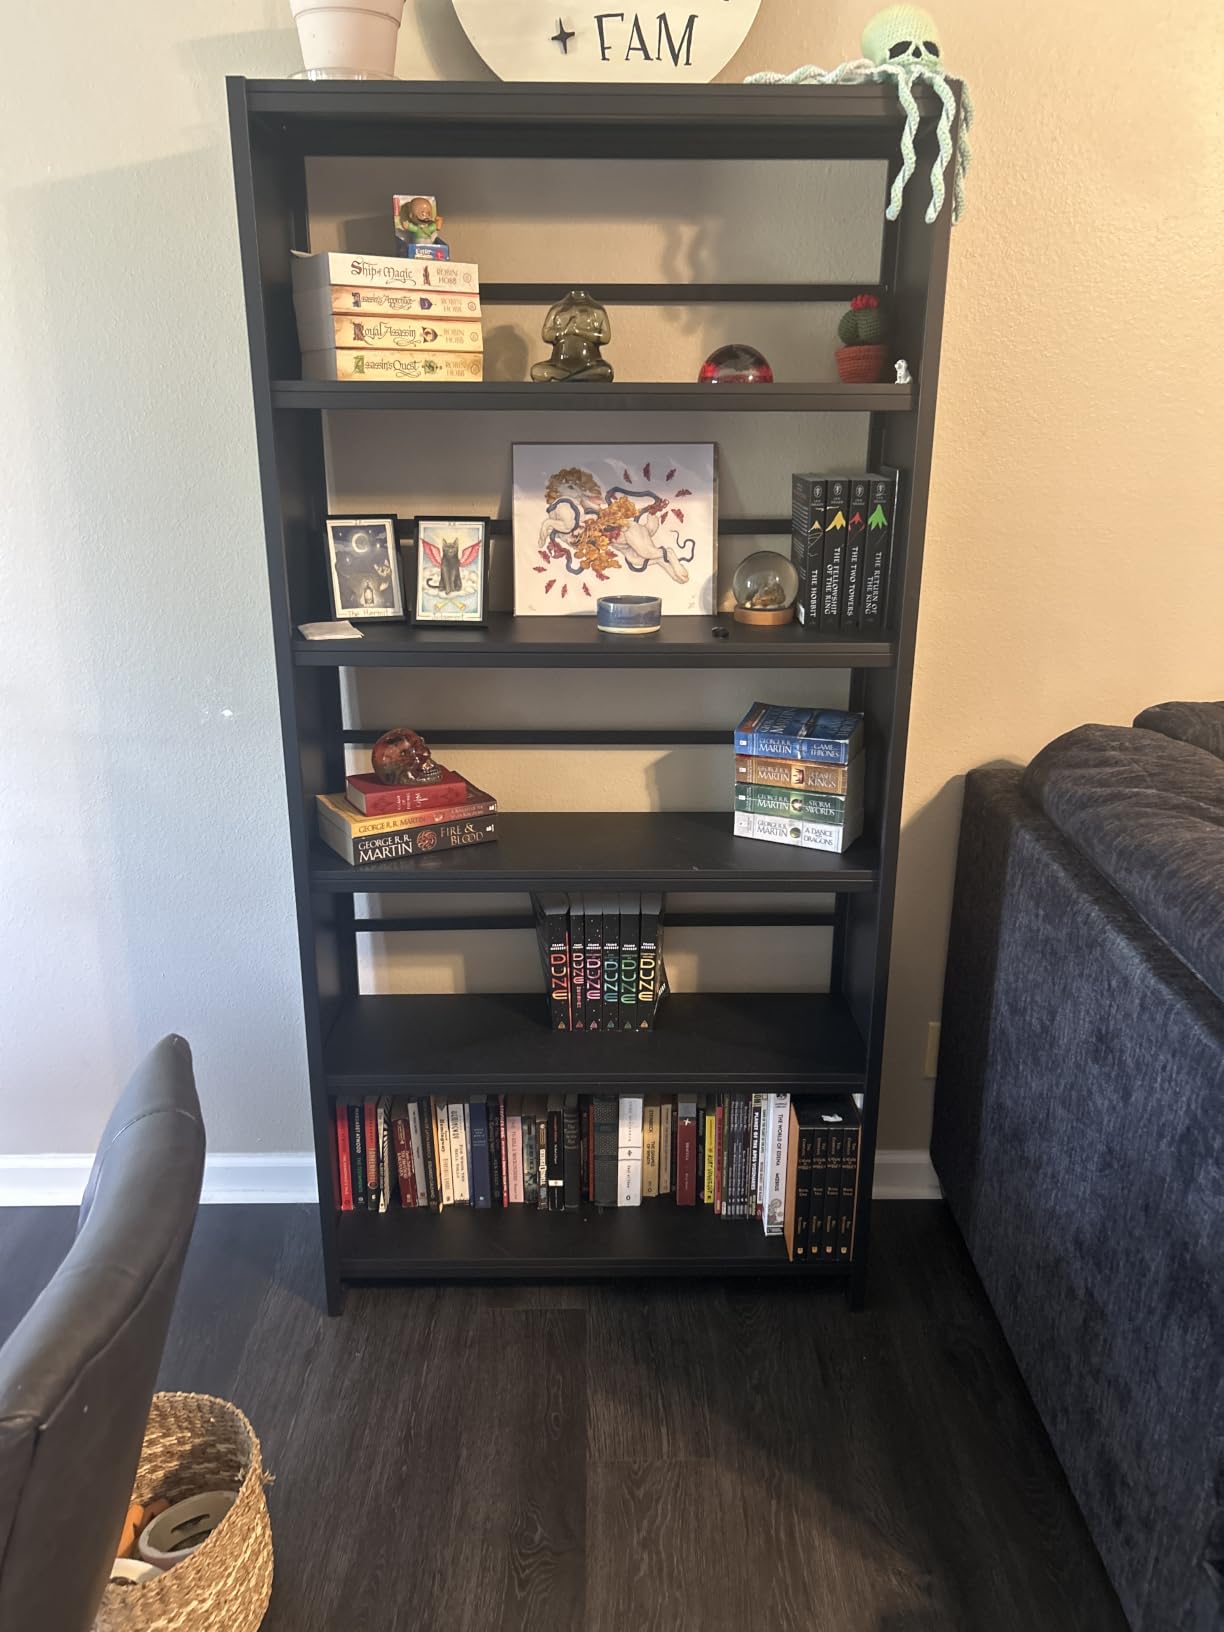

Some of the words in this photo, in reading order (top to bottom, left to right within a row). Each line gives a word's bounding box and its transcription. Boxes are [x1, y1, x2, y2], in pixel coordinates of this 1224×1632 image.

[594, 12, 698, 67] FAM
[351, 260, 376, 280] Ship
[383, 267, 415, 285] Magic
[437, 268, 458, 276] ROBIN
[438, 276, 457, 284] HOBB
[352, 322, 383, 345] Royal
[382, 326, 416, 343] Assassin
[353, 356, 393, 374] Assassin's
[393, 360, 419, 376] Quest
[833, 547, 841, 564] THE
[851, 546, 859, 562] THE
[874, 552, 882, 568] THE
[826, 564, 833, 575] OF
[831, 566, 839, 614] FELLOWSHIP
[872, 570, 880, 601] RETURN
[846, 584, 856, 616] TOWERS
[871, 603, 878, 614] OF
[760, 744, 792, 754] MARTIN
[811, 749, 839, 758] THRONES
[758, 771, 790, 780] MARTIN
[808, 778, 836, 788] KINGS
[758, 800, 790, 810] MARTIN
[805, 806, 835, 816] SWORDS
[358, 822, 385, 833] GEORGE
[400, 816, 426, 826] MARTIN
[440, 824, 462, 838] FIRE
[464, 822, 474, 833] &
[757, 826, 787, 837] MARTIN
[451, 831, 484, 846] BLOOD
[804, 836, 833, 846] DRAGONS
[812, 829, 832, 837] DANCE
[359, 838, 392, 850] GEORGE
[359, 842, 412, 862] MARTIN
[573, 953, 584, 984] DUNE
[550, 954, 568, 1000] DUNE
[586, 959, 600, 1000] DUNE
[604, 961, 618, 1002] DUNE
[620, 960, 637, 1004] DUNE
[638, 958, 655, 1001] DUNE
